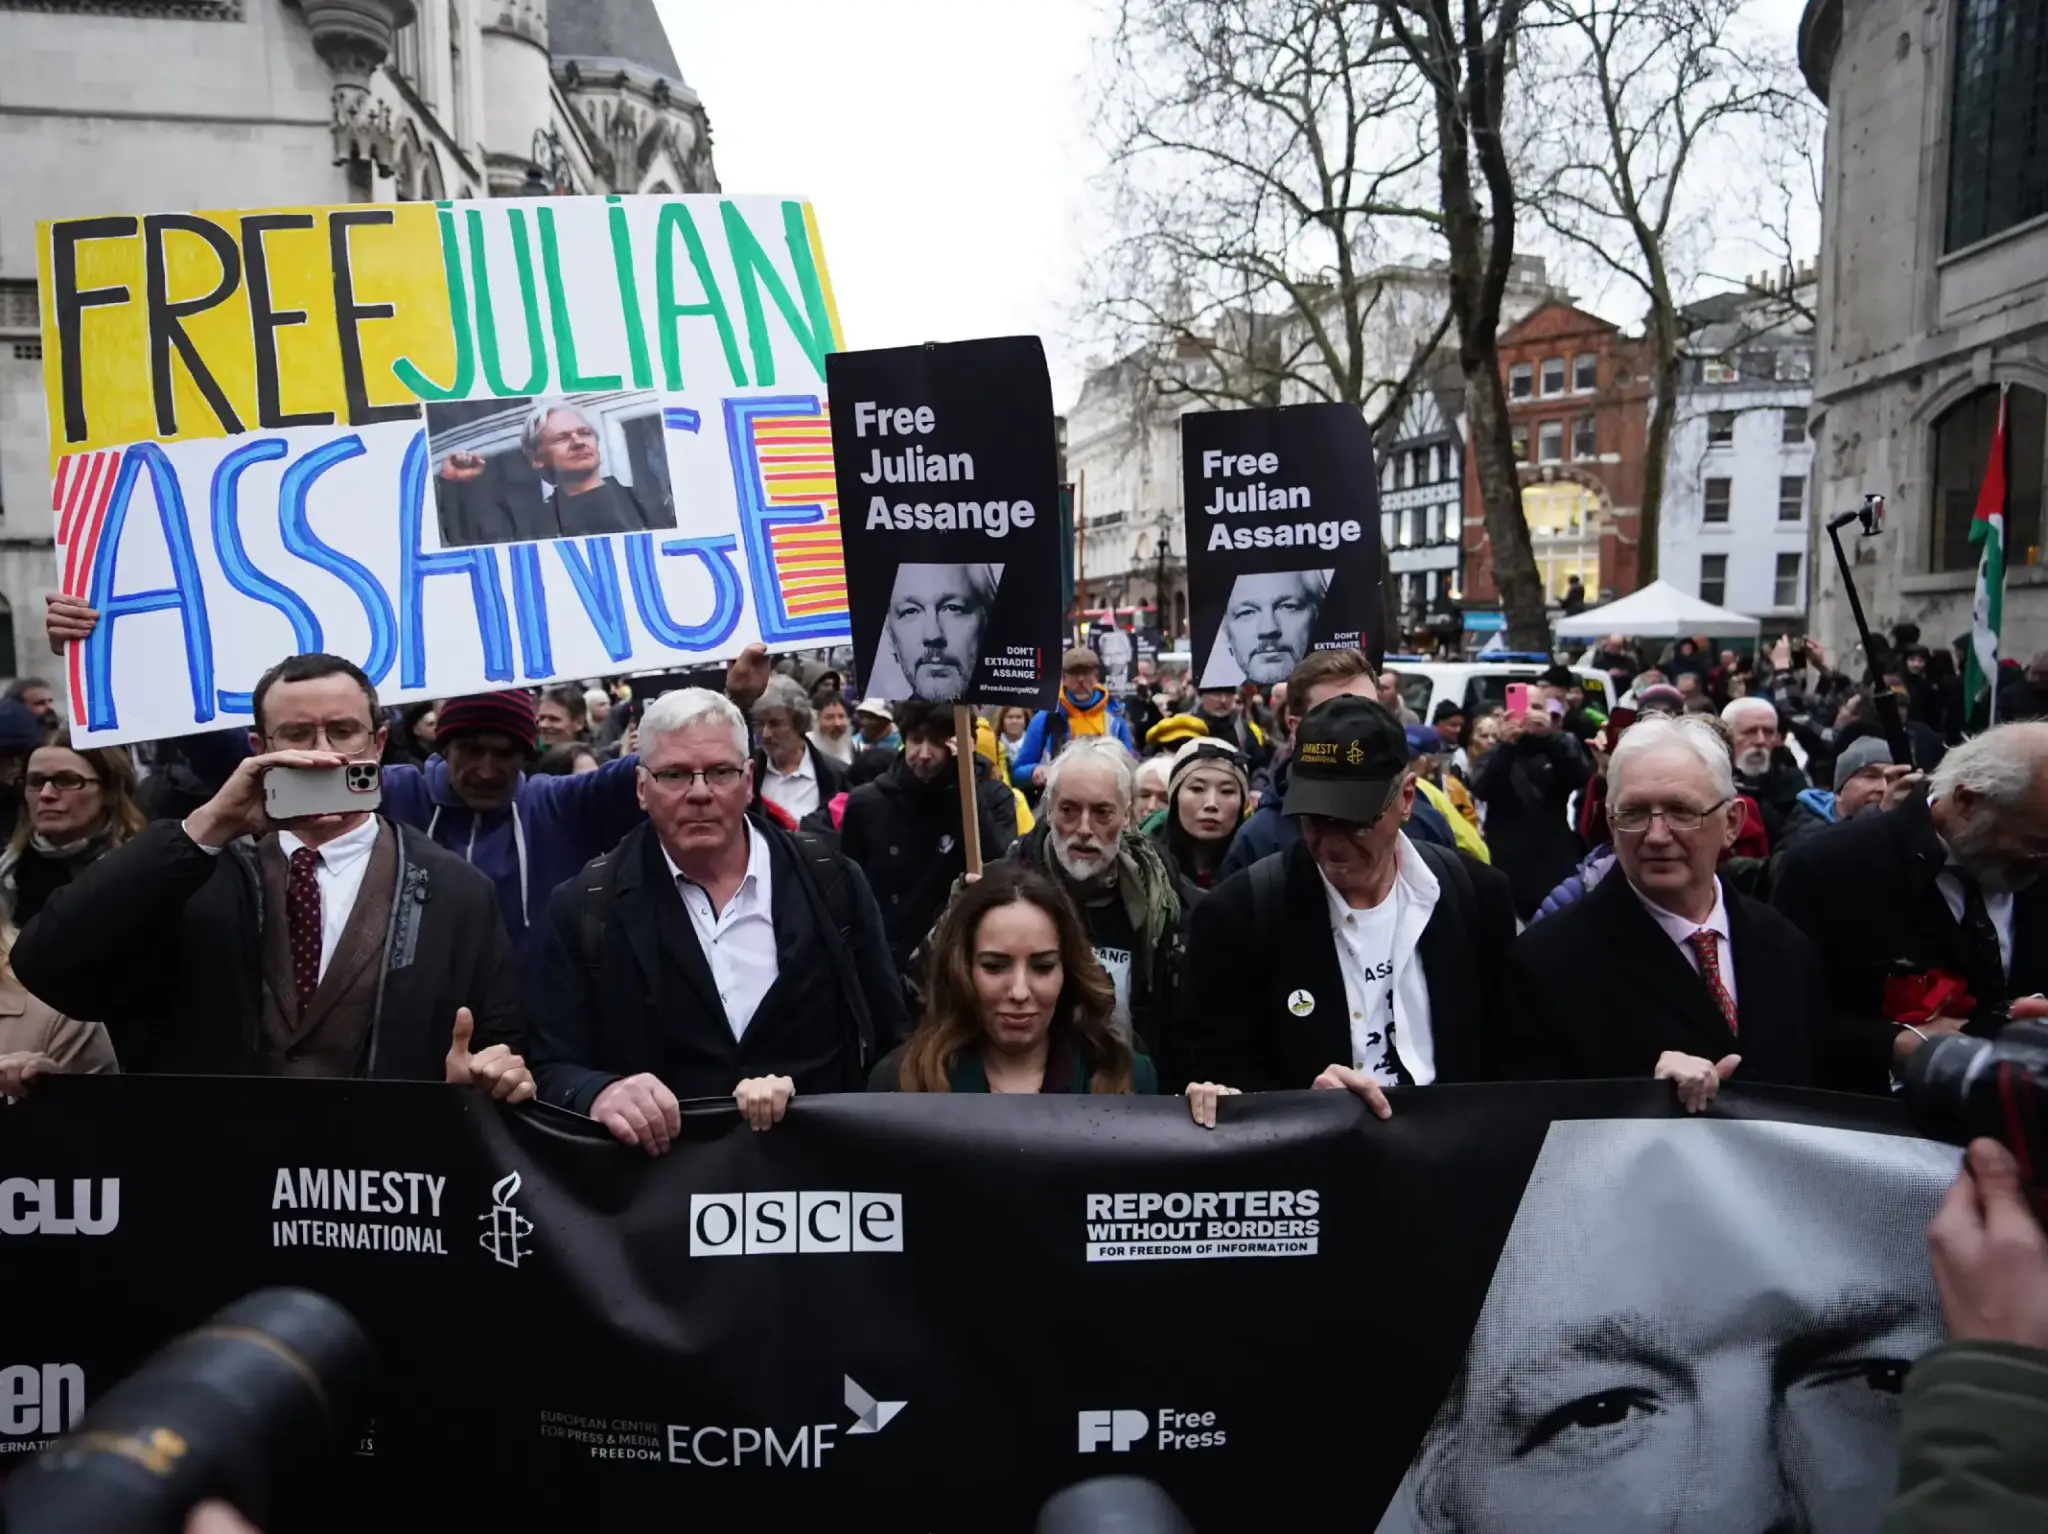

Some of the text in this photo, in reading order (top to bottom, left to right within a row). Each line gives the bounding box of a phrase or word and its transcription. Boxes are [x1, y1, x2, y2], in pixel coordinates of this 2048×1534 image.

[52, 211, 422, 442] FREE
[854, 401, 936, 437] Free
[860, 445, 975, 484] Julian
[1202, 449, 1279, 478] Free
[1204, 482, 1311, 515] Julian
[865, 495, 1036, 538] Assange
[1207, 519, 1361, 551] Assange
[1314, 641, 1359, 650] EXTRADITE
[1334, 632, 1360, 640] DON'T
[984, 657, 1035, 668] EXTRADITE
[1006, 646, 1034, 656] DON'T
[992, 669, 1035, 679] ASSANGE
[979, 684, 1040, 694] #FreeAssangeNOW
[271, 1167, 447, 1217] AMNESTY
[1086, 1189, 1320, 1220] REPORTERS
[273, 1220, 448, 1255] INTERNATIONAL
[1086, 1219, 1320, 1241] WITHOUT BORDERS
[1100, 1242, 1308, 1256] FOR FREEDOM OF INFORMATION
[540, 1410, 659, 1434] EUROPEAN CENTRE
[1158, 1409, 1216, 1429] Free
[541, 1424, 660, 1447] FOR PRESS & MEDIA
[1078, 1410, 1149, 1453] FP
[1158, 1429, 1226, 1450] Press
[591, 1447, 661, 1461] FREEDOM
[667, 1424, 838, 1468] ECPMF
